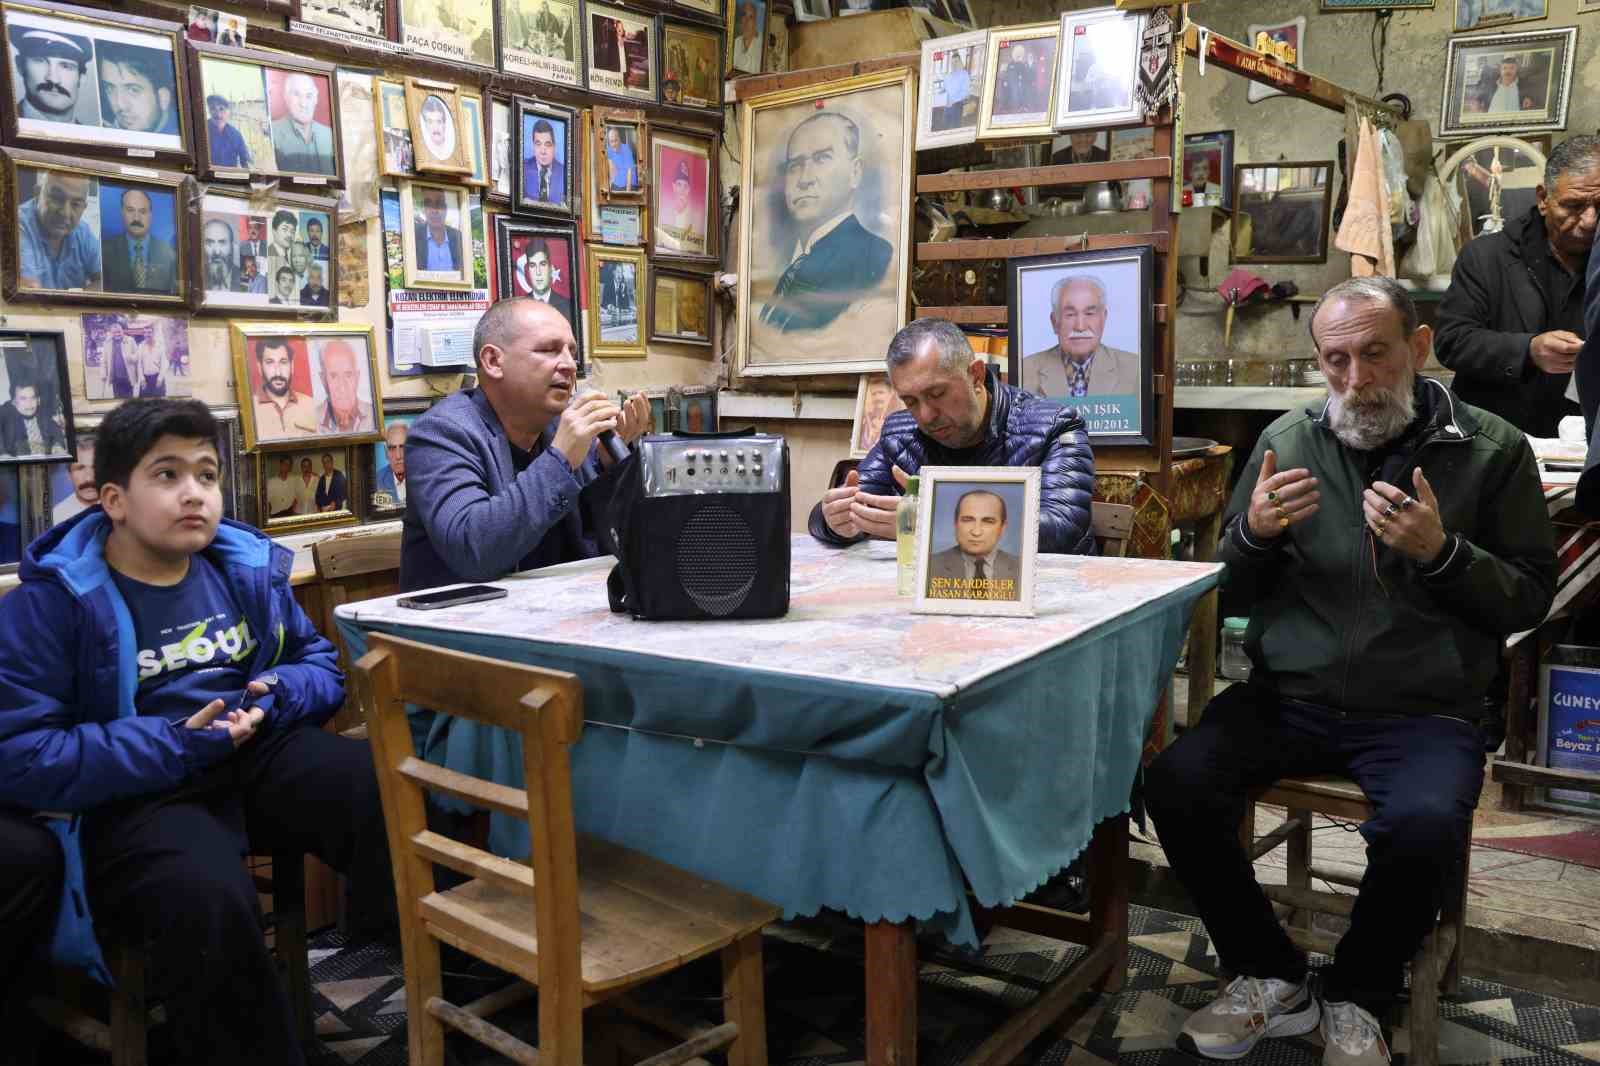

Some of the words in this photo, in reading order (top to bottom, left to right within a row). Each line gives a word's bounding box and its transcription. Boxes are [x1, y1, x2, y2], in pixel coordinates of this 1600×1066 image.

[1094, 402, 1121, 417] IŞIK
[136, 621, 258, 679] SEOUL
[1556, 738, 1593, 752] Beyaz
